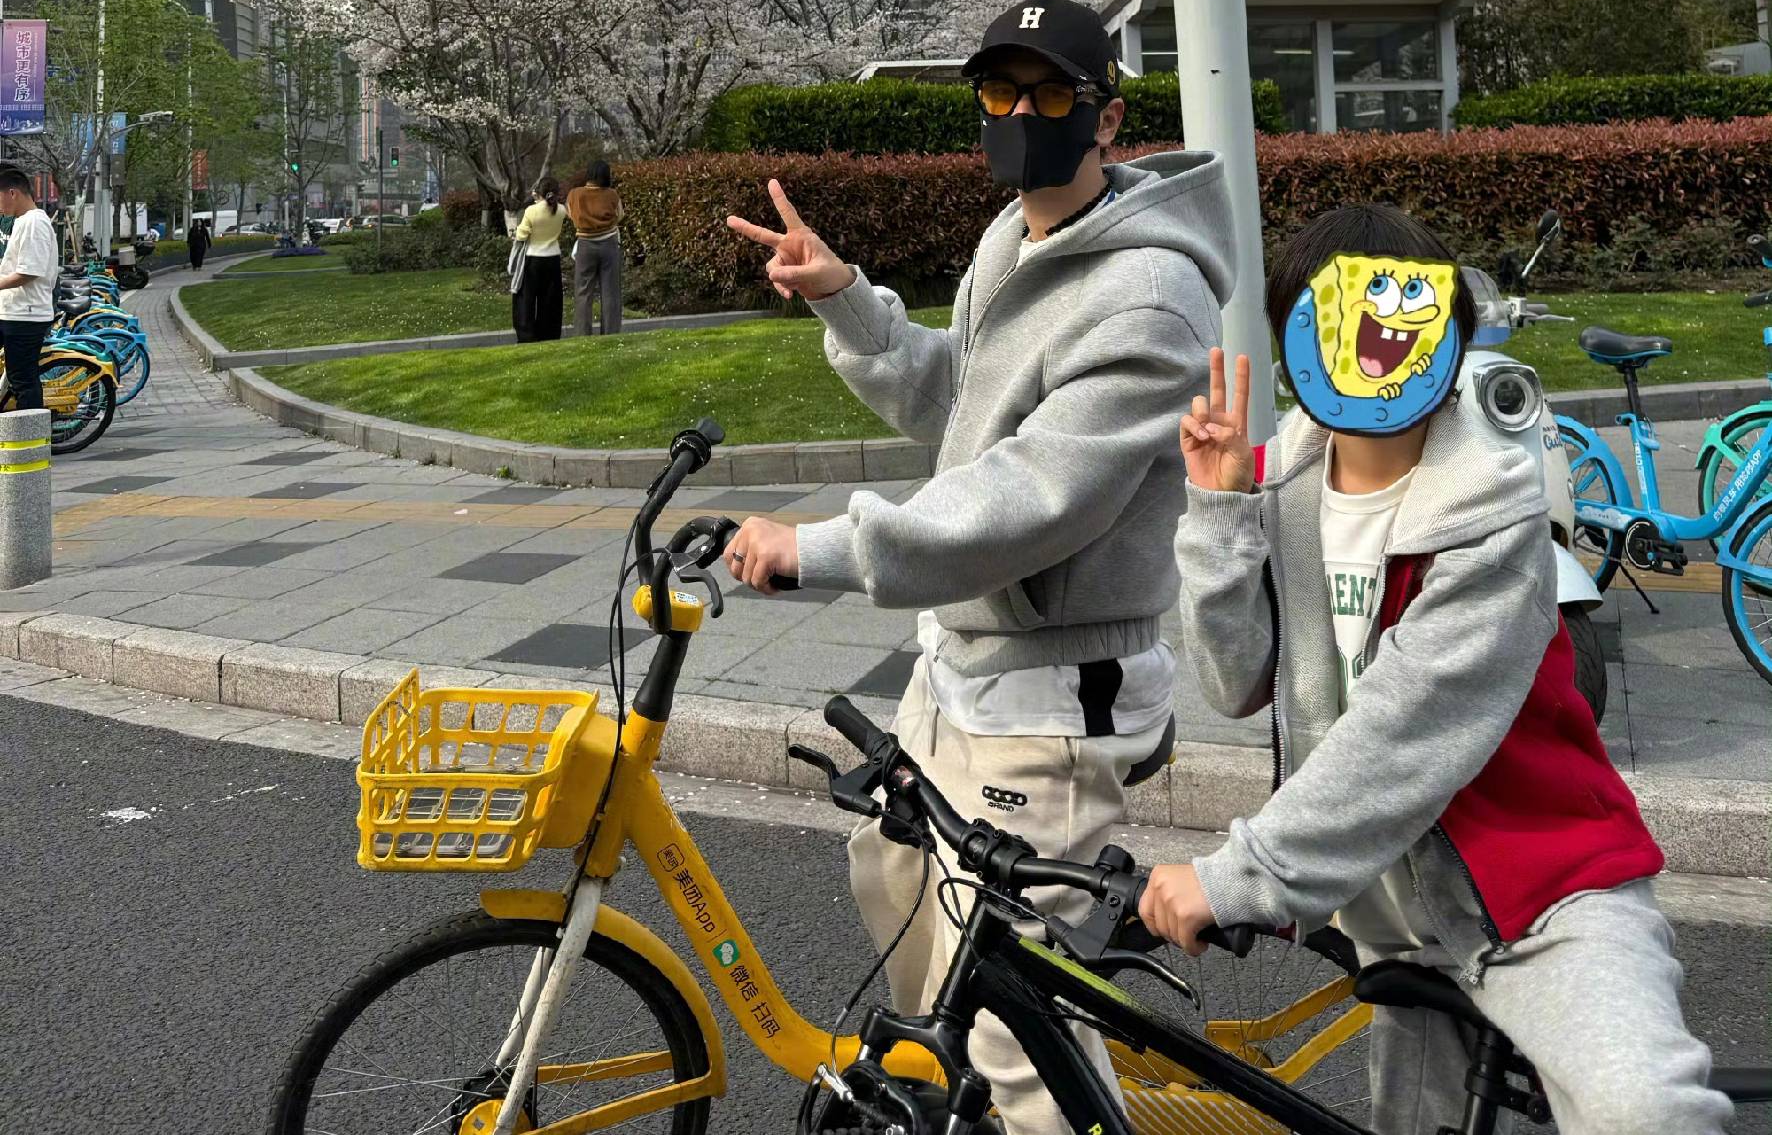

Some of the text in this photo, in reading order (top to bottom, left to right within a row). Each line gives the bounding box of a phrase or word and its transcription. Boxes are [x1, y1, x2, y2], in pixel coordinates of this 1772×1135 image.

[1019, 7, 1045, 28] H
[14, 30, 32, 102] 城市更有序
[672, 868, 716, 933] 美团App
